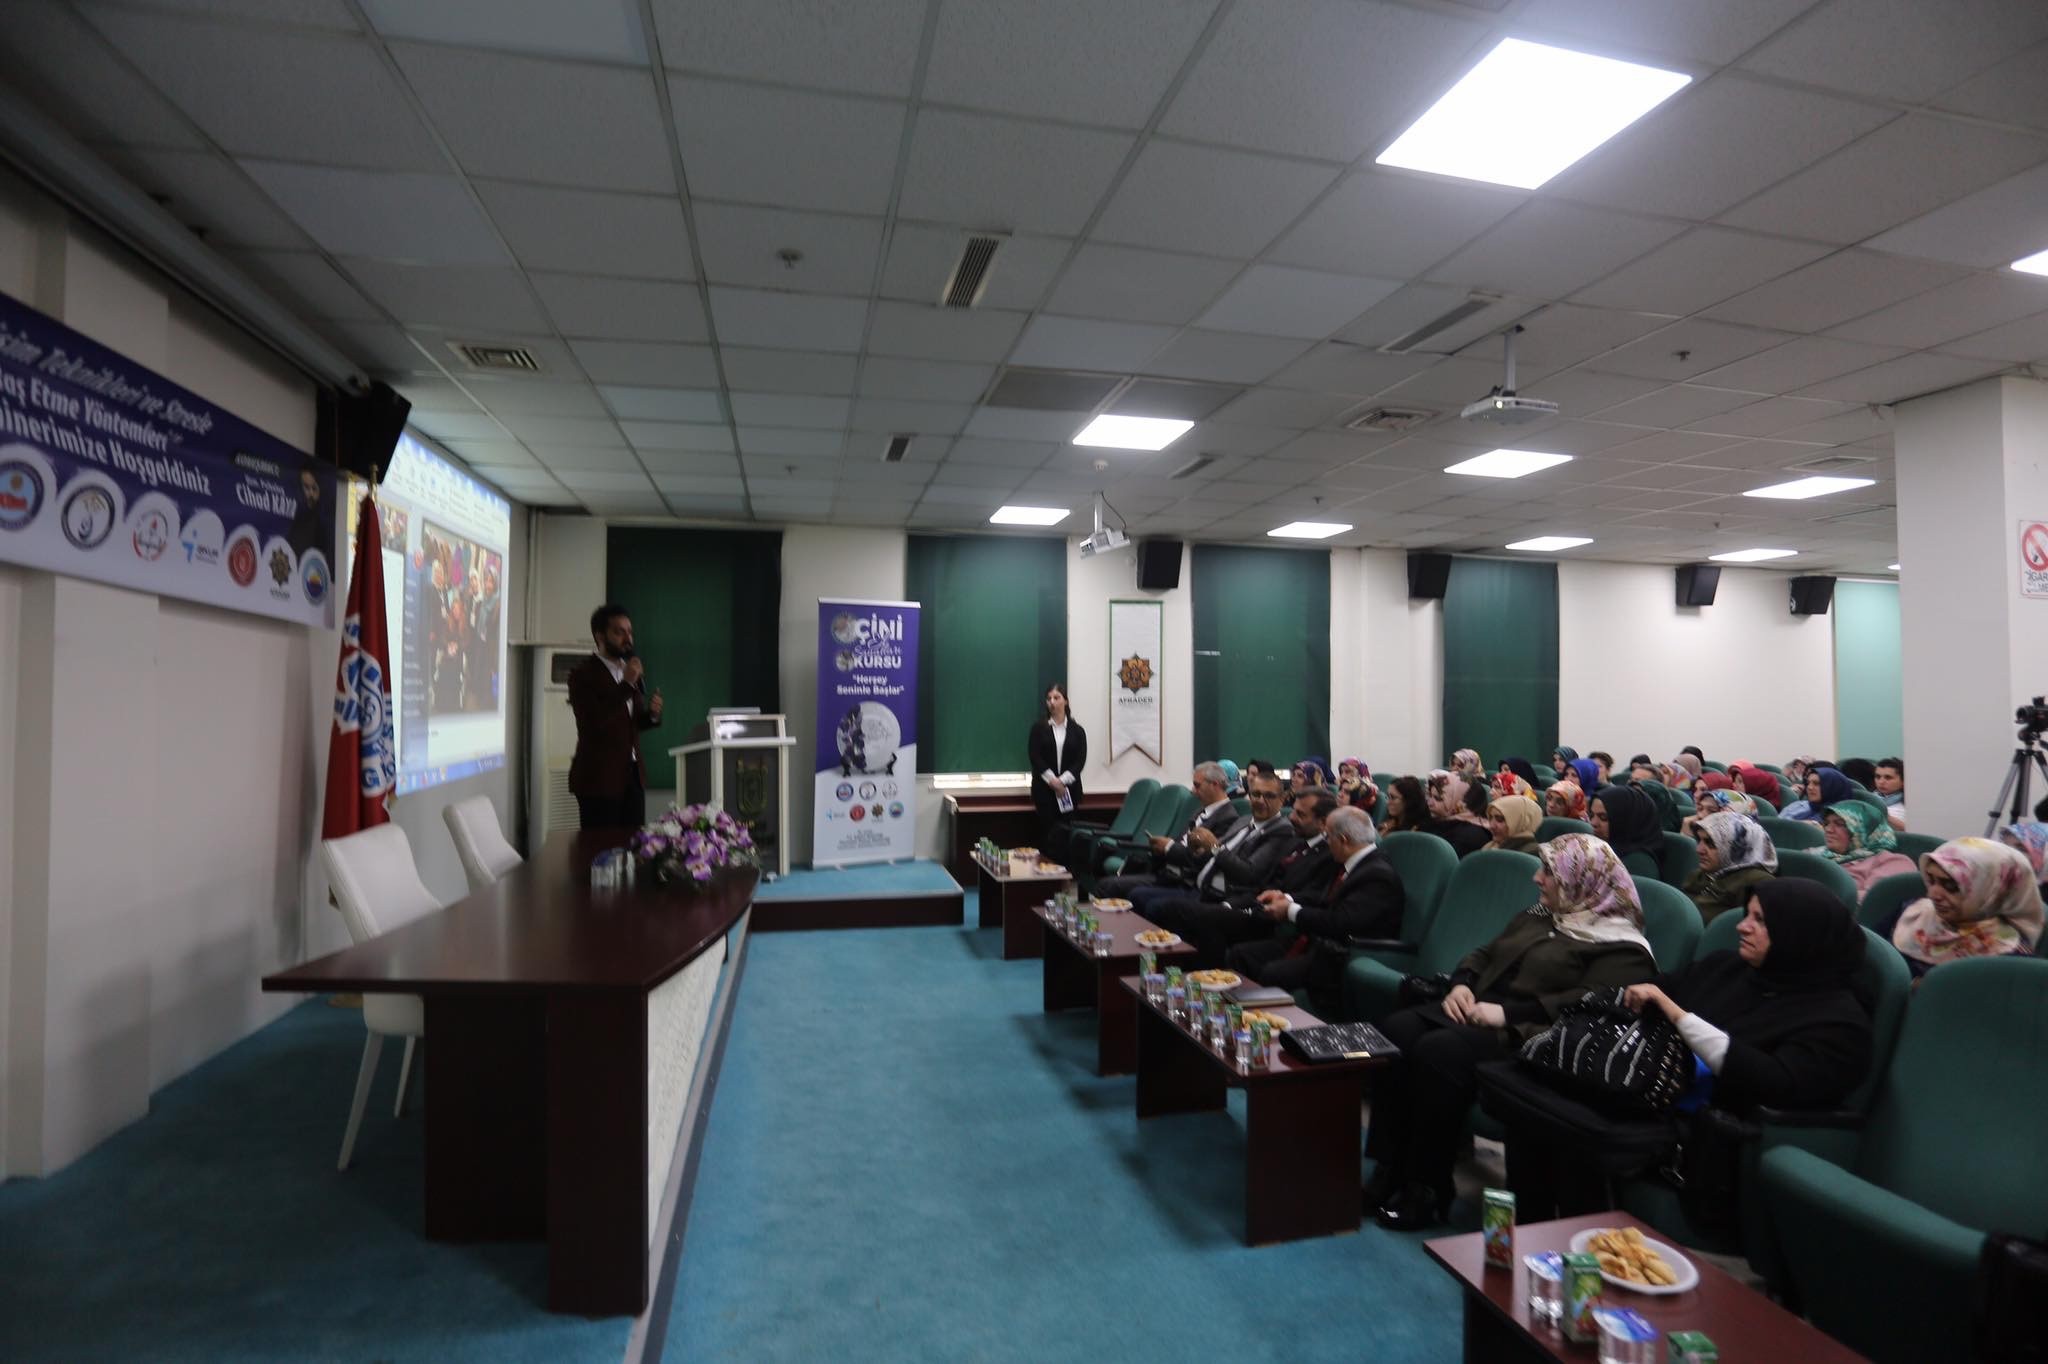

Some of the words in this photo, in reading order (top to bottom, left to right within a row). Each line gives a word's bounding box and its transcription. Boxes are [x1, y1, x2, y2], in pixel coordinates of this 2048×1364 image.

[0, 368, 26, 408] aş
[30, 375, 80, 421] Etme
[108, 438, 212, 497] Hoşgeldiniz
[854, 612, 903, 645] ÇİNİ
[853, 655, 902, 669] KURSU
[837, 685, 871, 696] Seninle
